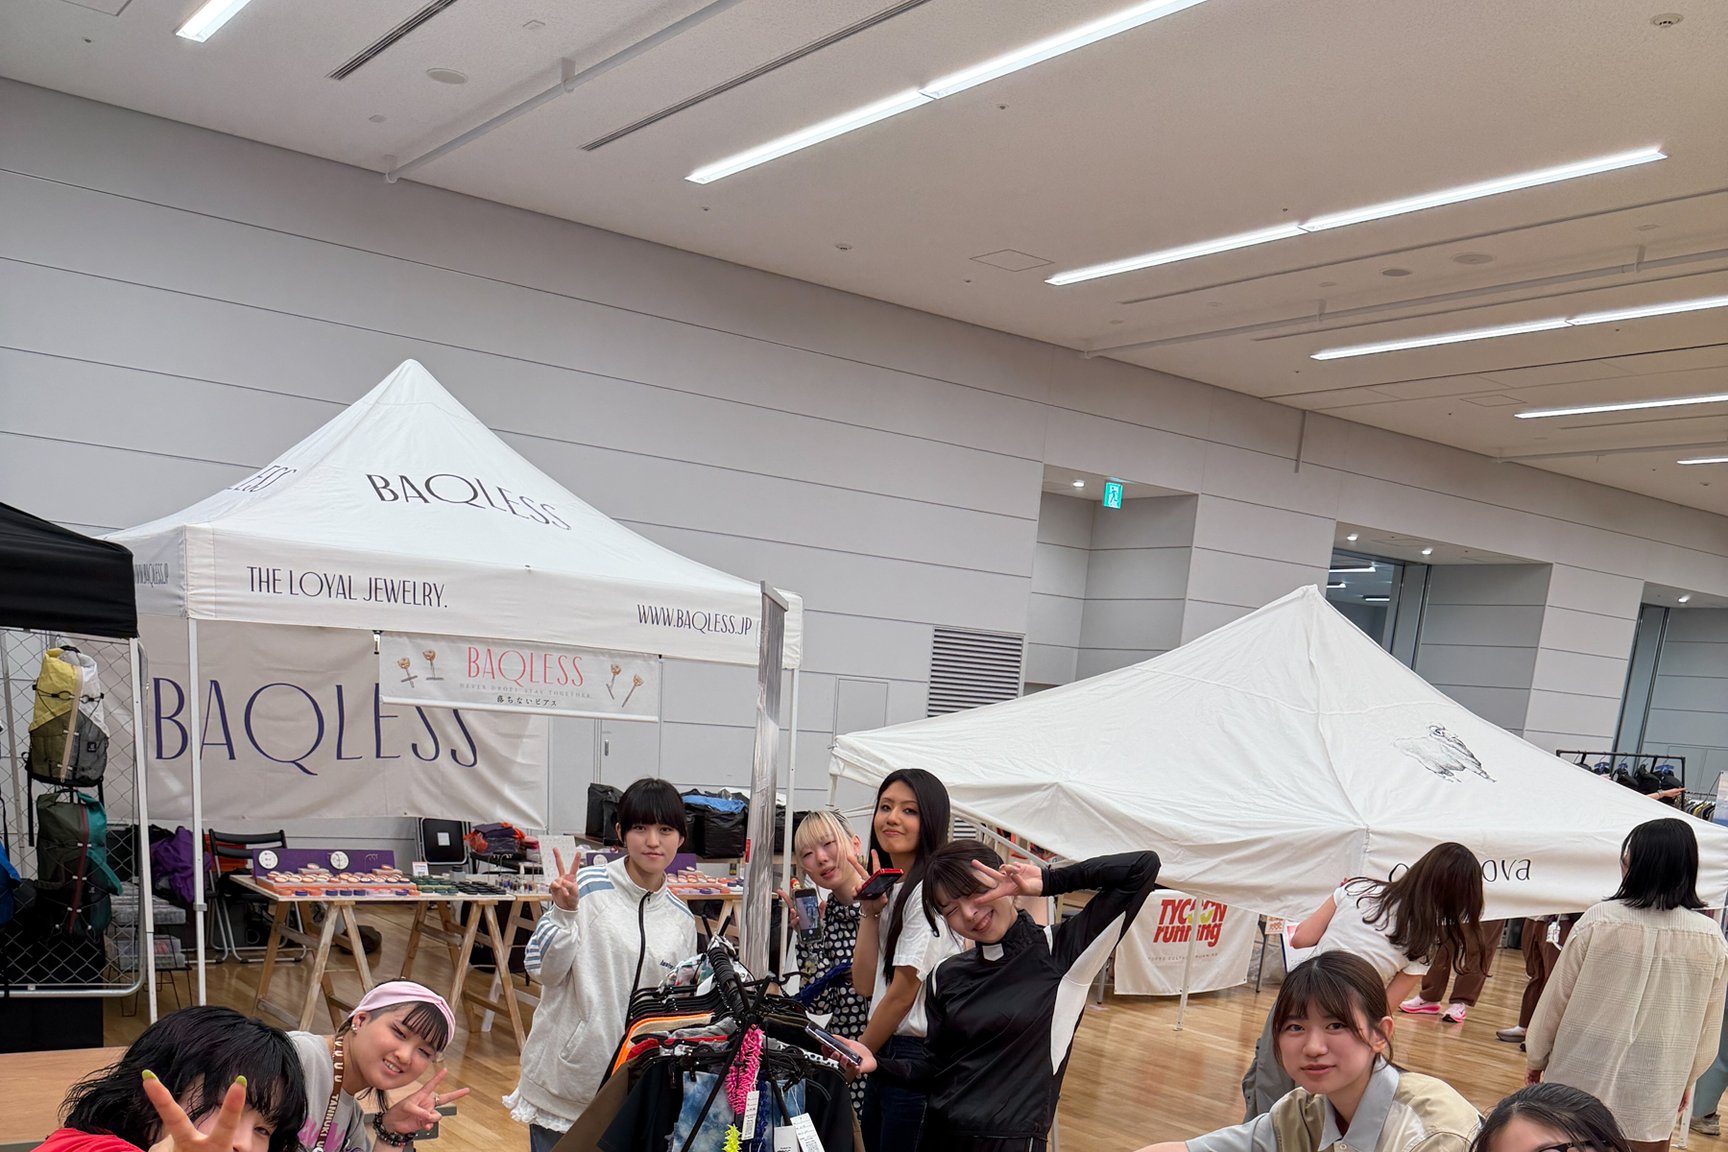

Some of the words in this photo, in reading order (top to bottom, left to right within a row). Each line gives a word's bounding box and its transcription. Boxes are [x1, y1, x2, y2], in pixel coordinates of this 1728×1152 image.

[366, 473, 572, 531] BAQLESS
[247, 566, 283, 594] THE
[289, 569, 358, 600] LOYAL
[363, 576, 448, 608] JEWELRY.
[637, 604, 753, 635] WWW.BAQLESS.JP
[467, 646, 584, 688] BAQLESS
